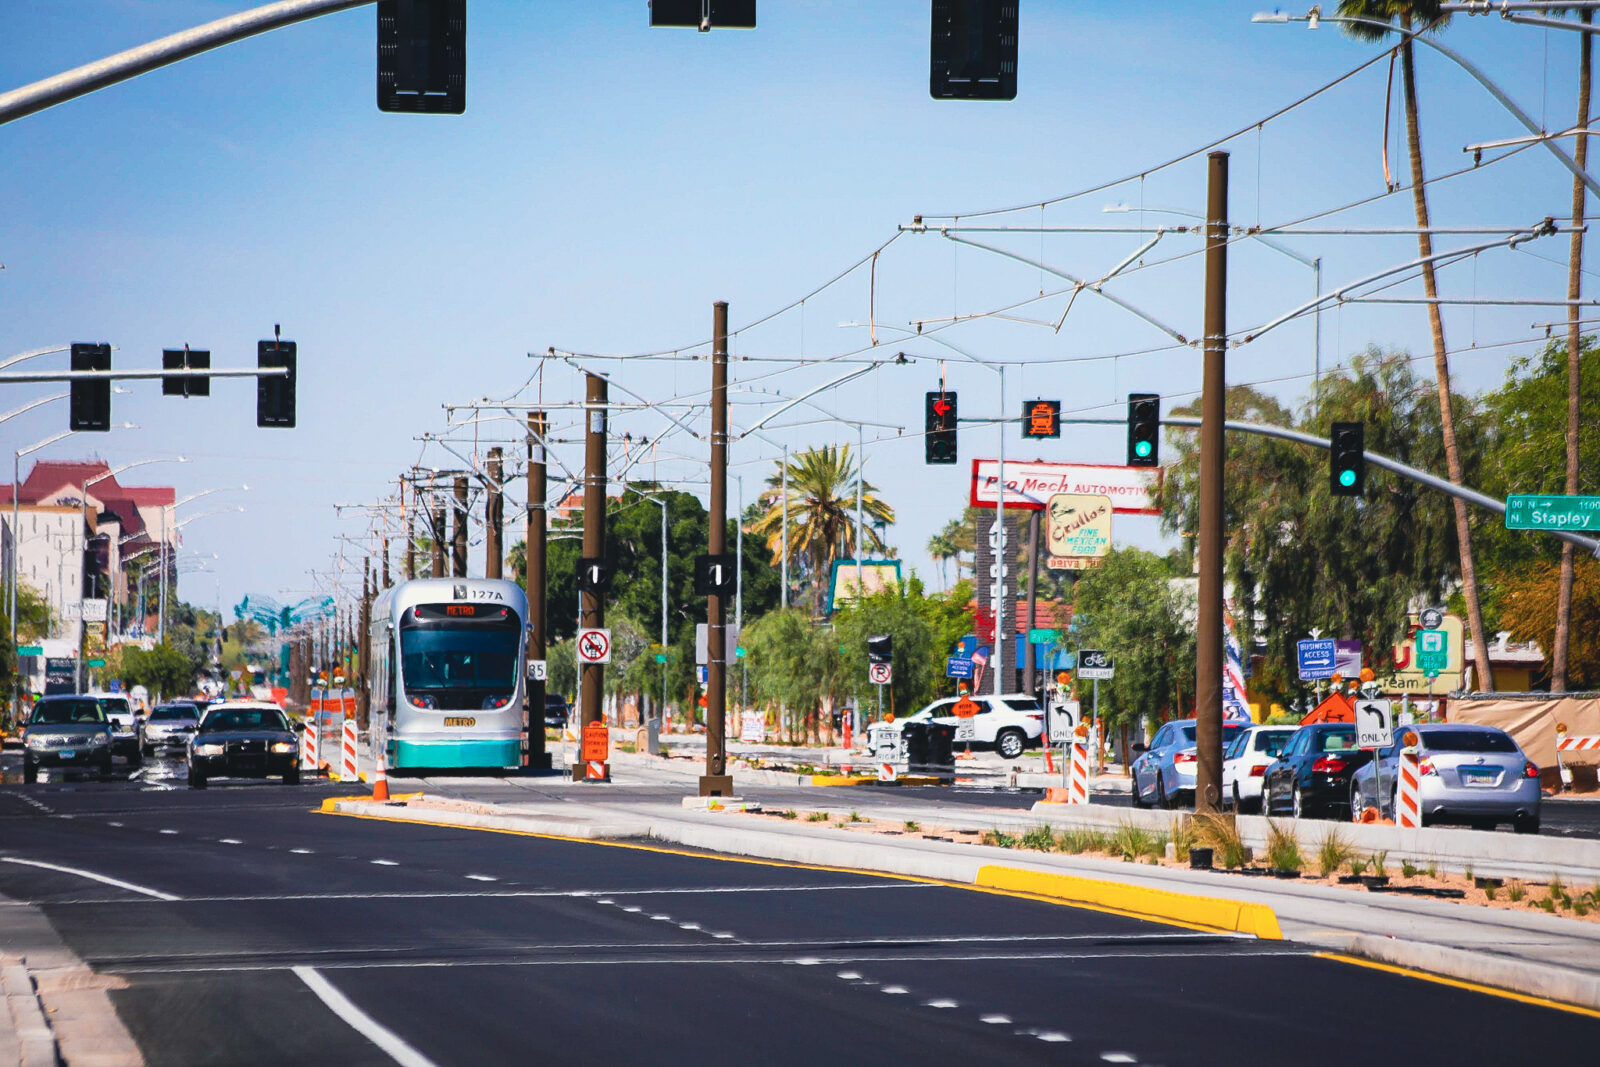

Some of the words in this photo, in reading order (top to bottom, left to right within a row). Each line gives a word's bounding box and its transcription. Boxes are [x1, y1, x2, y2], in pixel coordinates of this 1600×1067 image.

[984, 476, 1018, 490] Po
[1021, 474, 1068, 495] Mech
[1073, 484, 1148, 496] AUTOMOTIV
[1528, 501, 1535, 509] N
[1532, 511, 1591, 528] Stapley
[1079, 528, 1099, 537] FINE
[1065, 537, 1107, 546] MEXICAN
[1071, 545, 1097, 554] FOOD
[1050, 560, 1080, 568] DRIVE
[472, 590, 503, 600] 127A
[446, 605, 475, 616] METRO
[1300, 642, 1332, 650] BUSINESS
[1304, 651, 1330, 659] ACCESS
[444, 717, 475, 727] METRO
[960, 730, 975, 738] 25
[1361, 732, 1389, 743] ONLY
